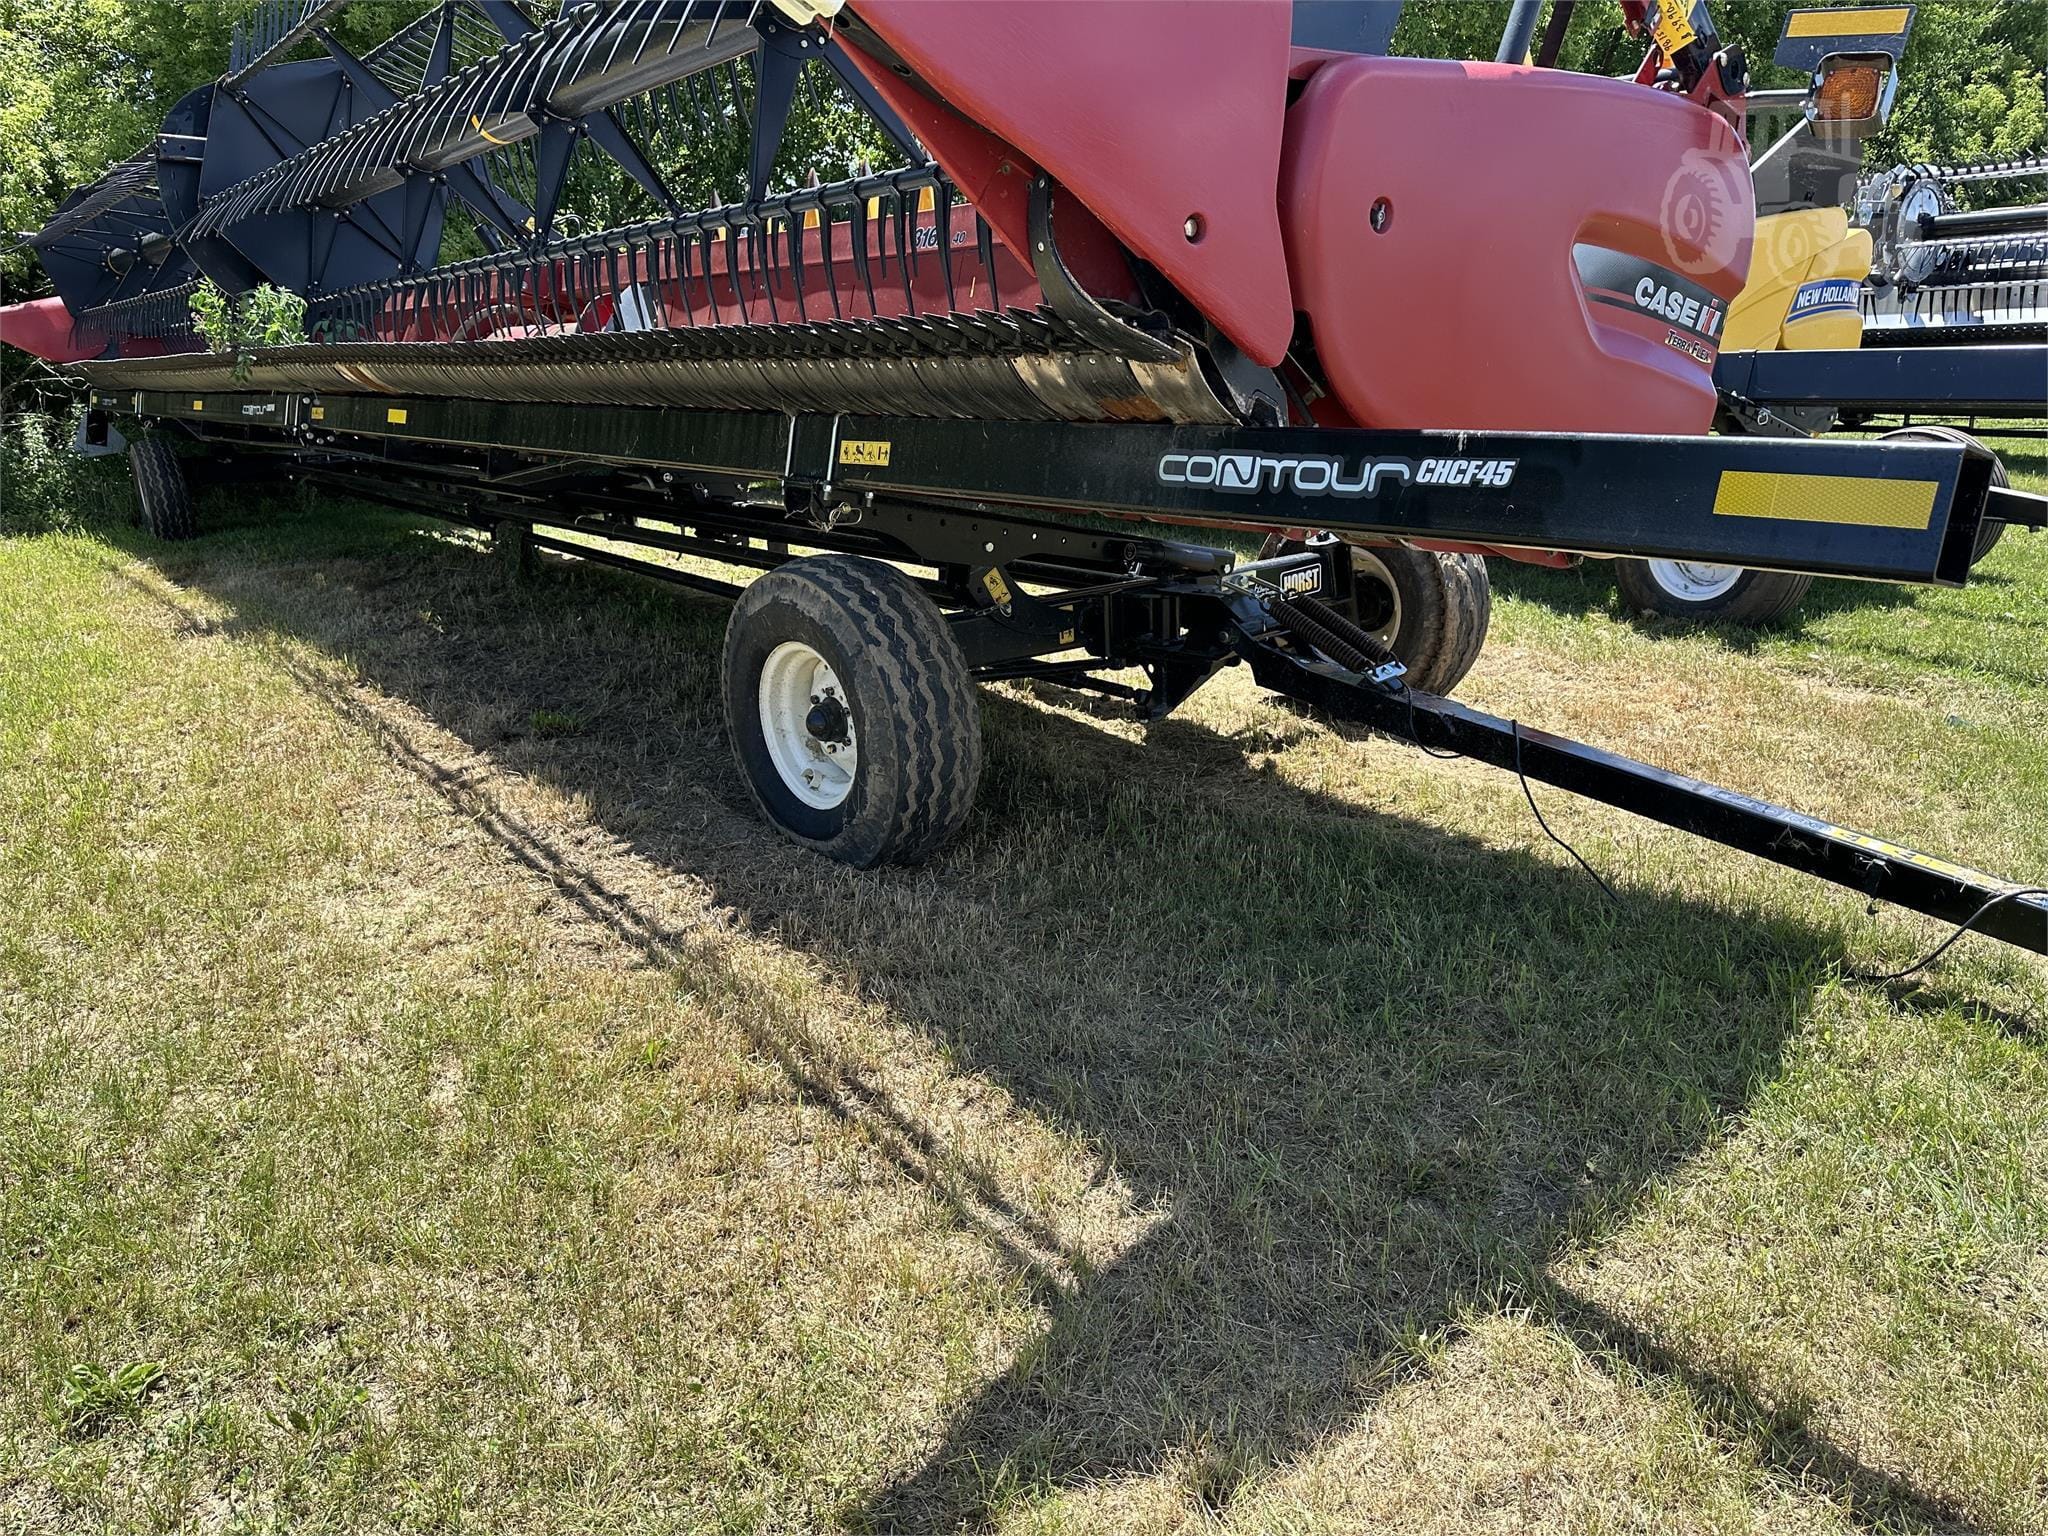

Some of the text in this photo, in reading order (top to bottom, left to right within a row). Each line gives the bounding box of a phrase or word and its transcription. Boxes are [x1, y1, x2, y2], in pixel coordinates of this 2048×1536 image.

[915, 226, 939, 248] 316
[1634, 277, 1700, 328] CASE
[1796, 285, 1859, 309] NEW HOLLAND
[1414, 458, 1517, 487] CHCF45
[1283, 567, 1320, 594] HORST
